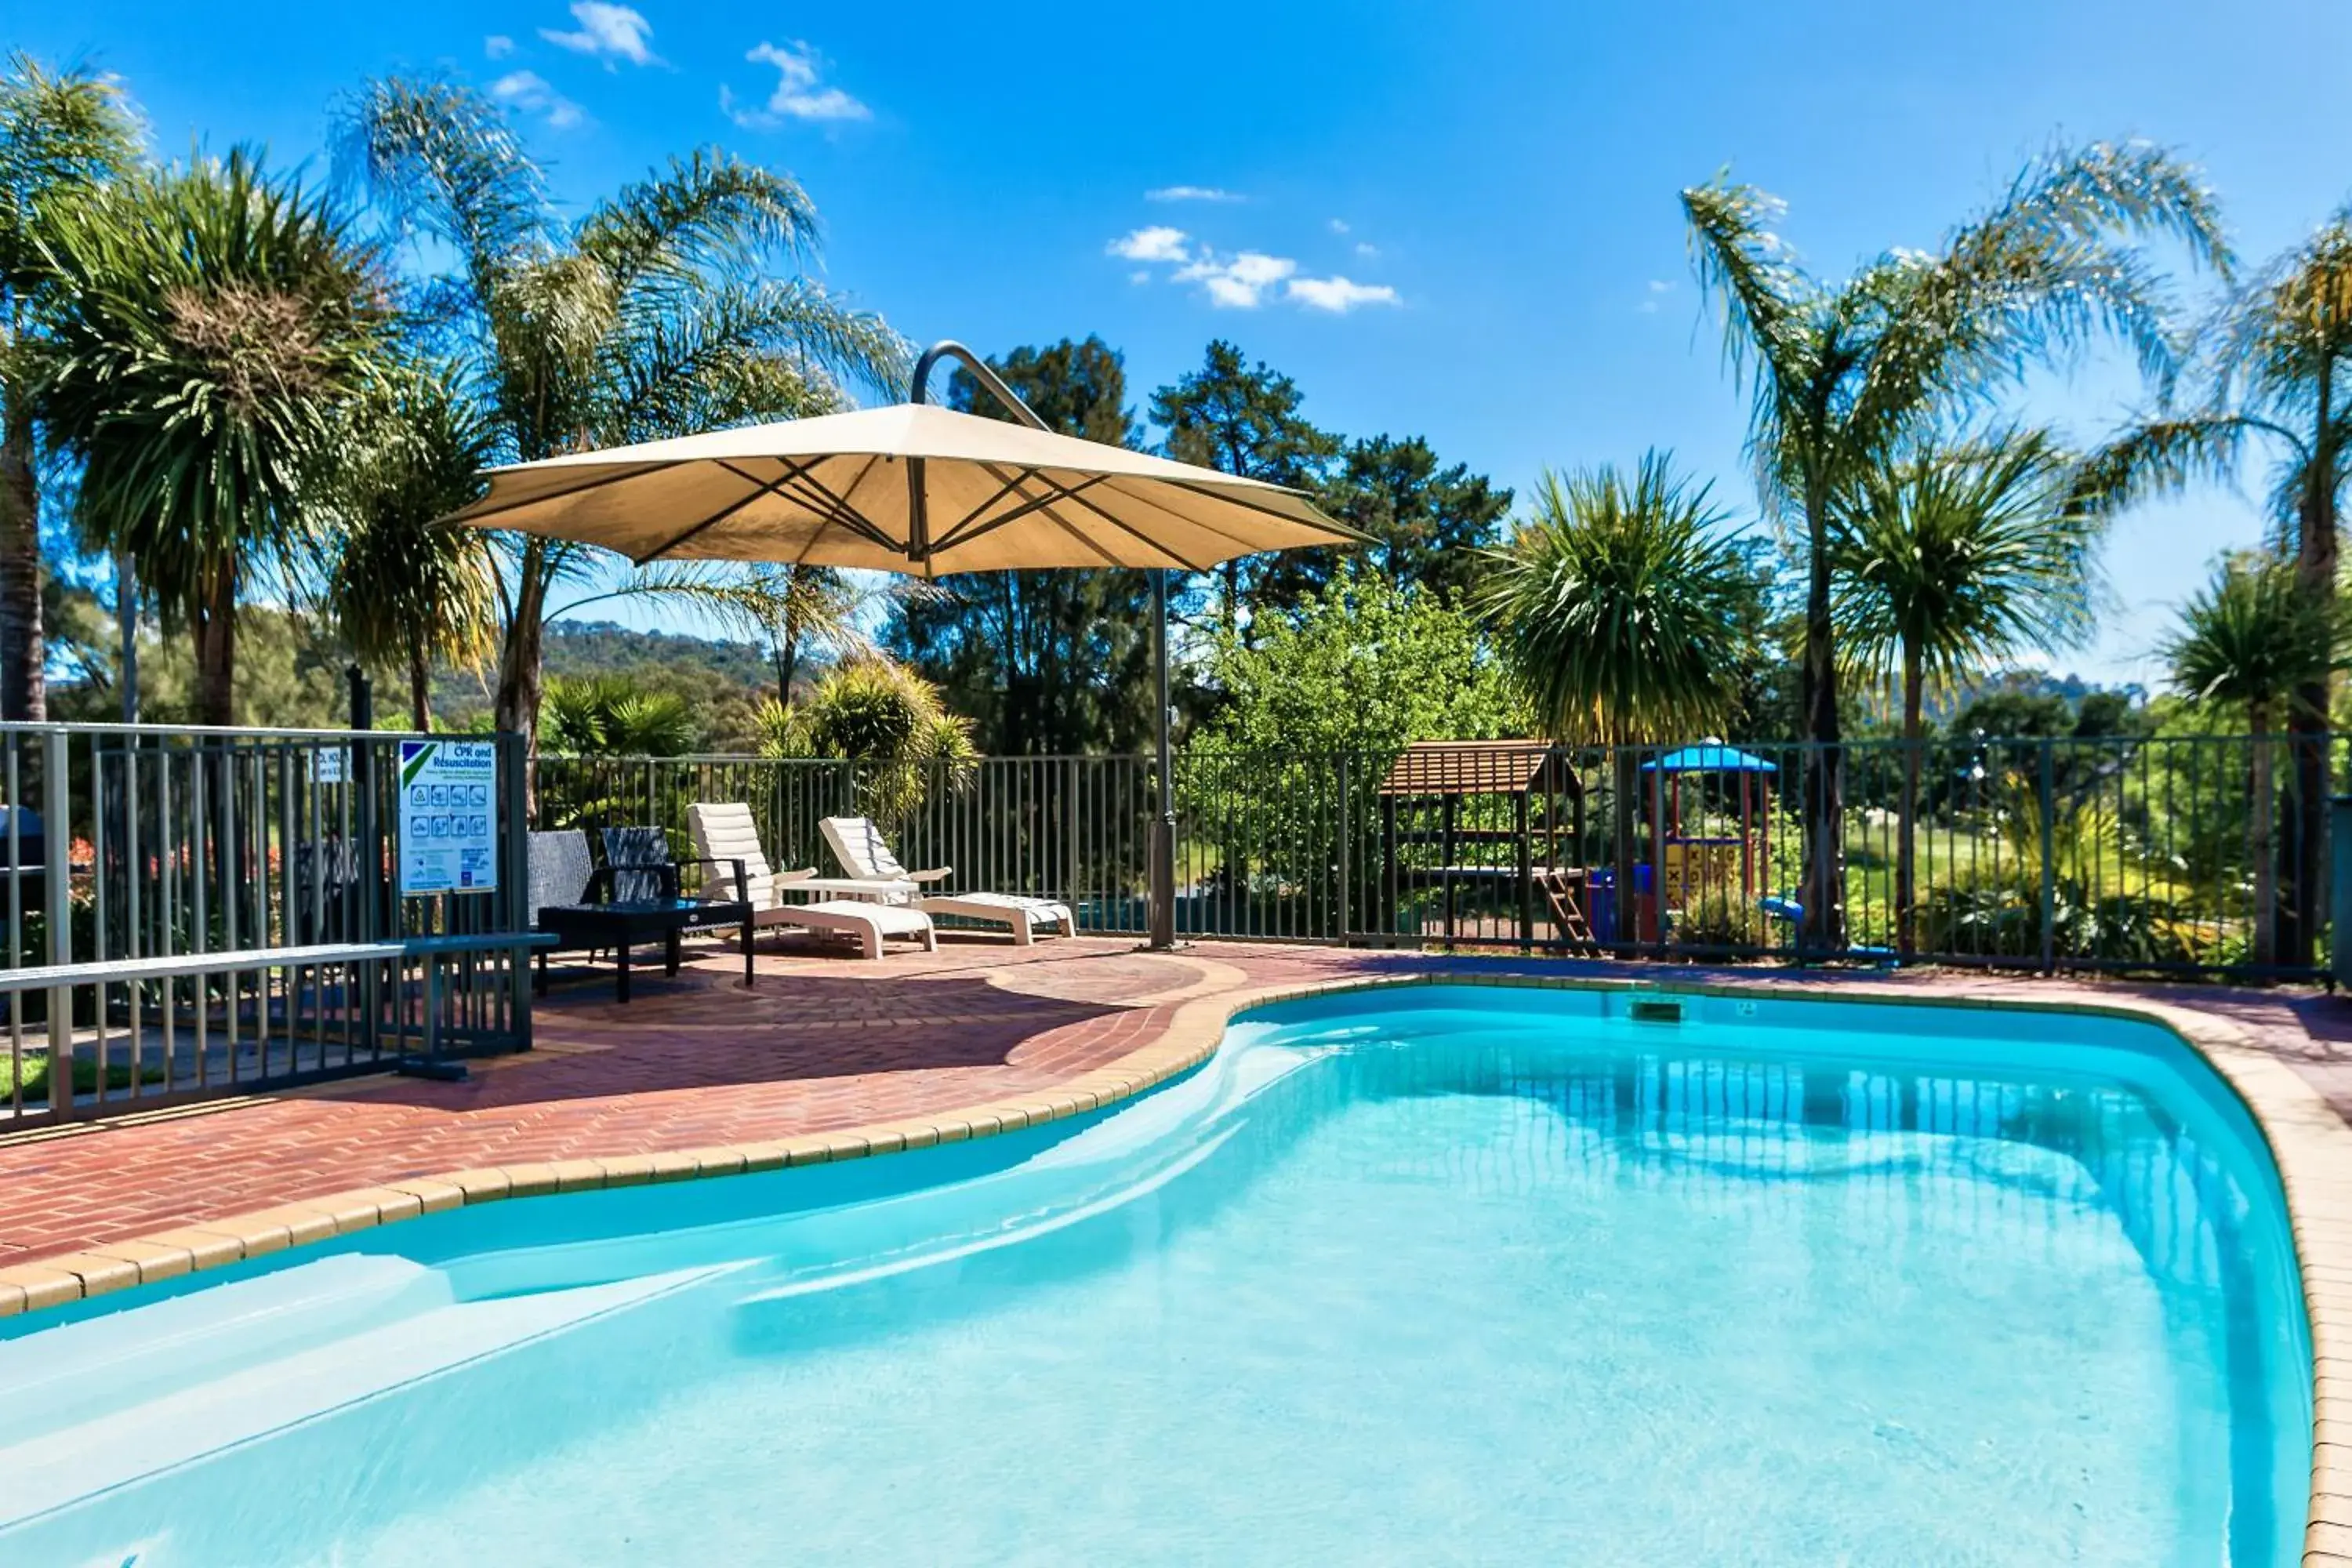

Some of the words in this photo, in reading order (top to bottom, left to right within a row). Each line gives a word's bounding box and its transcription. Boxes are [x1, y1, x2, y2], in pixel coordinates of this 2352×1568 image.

[455, 746, 473, 757] CPR
[475, 746, 492, 757] and
[434, 757, 492, 768] Resuscitation
